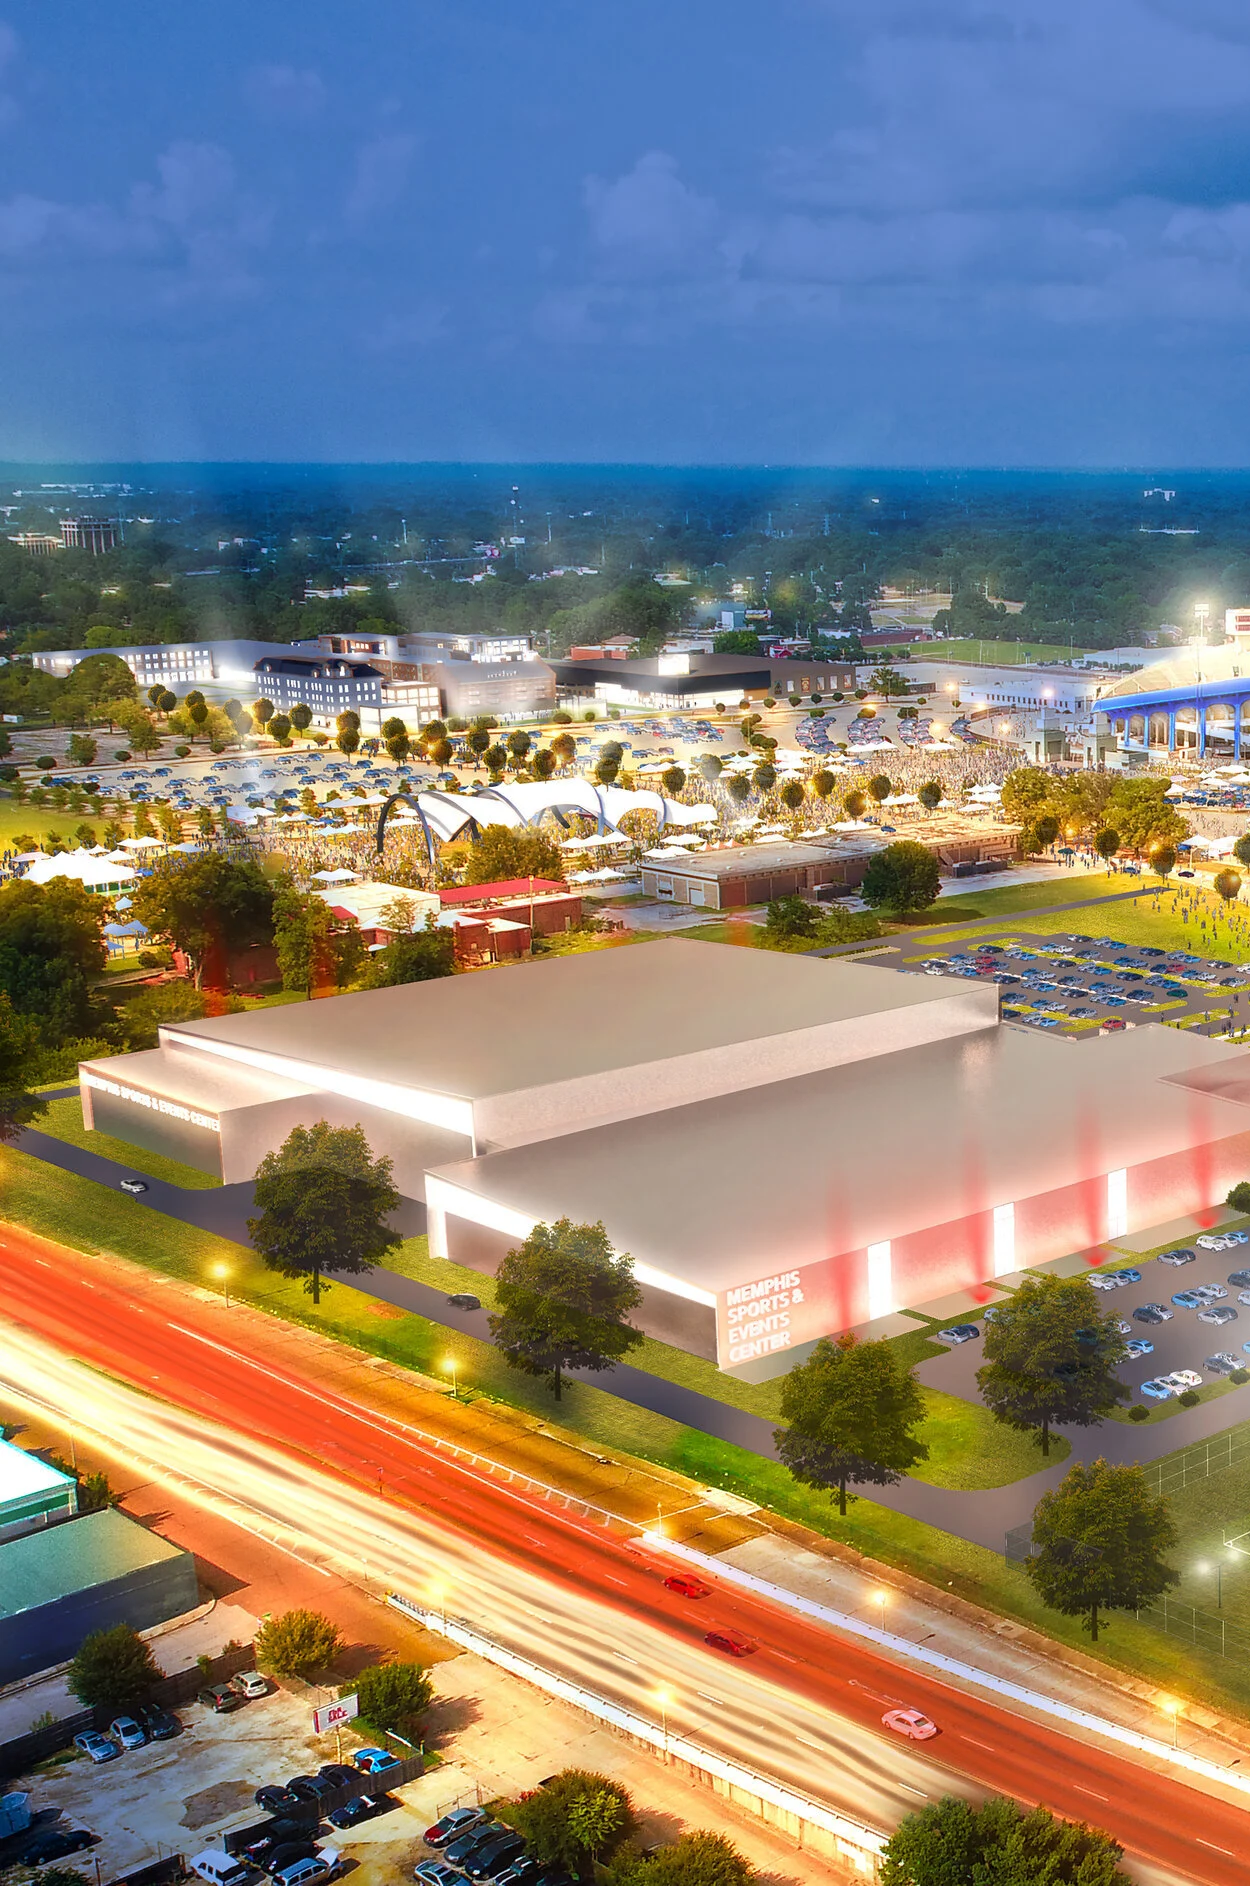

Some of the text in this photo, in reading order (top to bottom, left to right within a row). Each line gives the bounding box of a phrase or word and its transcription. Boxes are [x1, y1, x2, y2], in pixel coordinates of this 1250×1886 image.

[190, 1111, 221, 1132] CENTE
[726, 1270, 801, 1306] MEMPHIS
[727, 1288, 805, 1324] SPORTS &
[728, 1311, 791, 1344] EVENTS
[728, 1331, 791, 1363] CENTER
